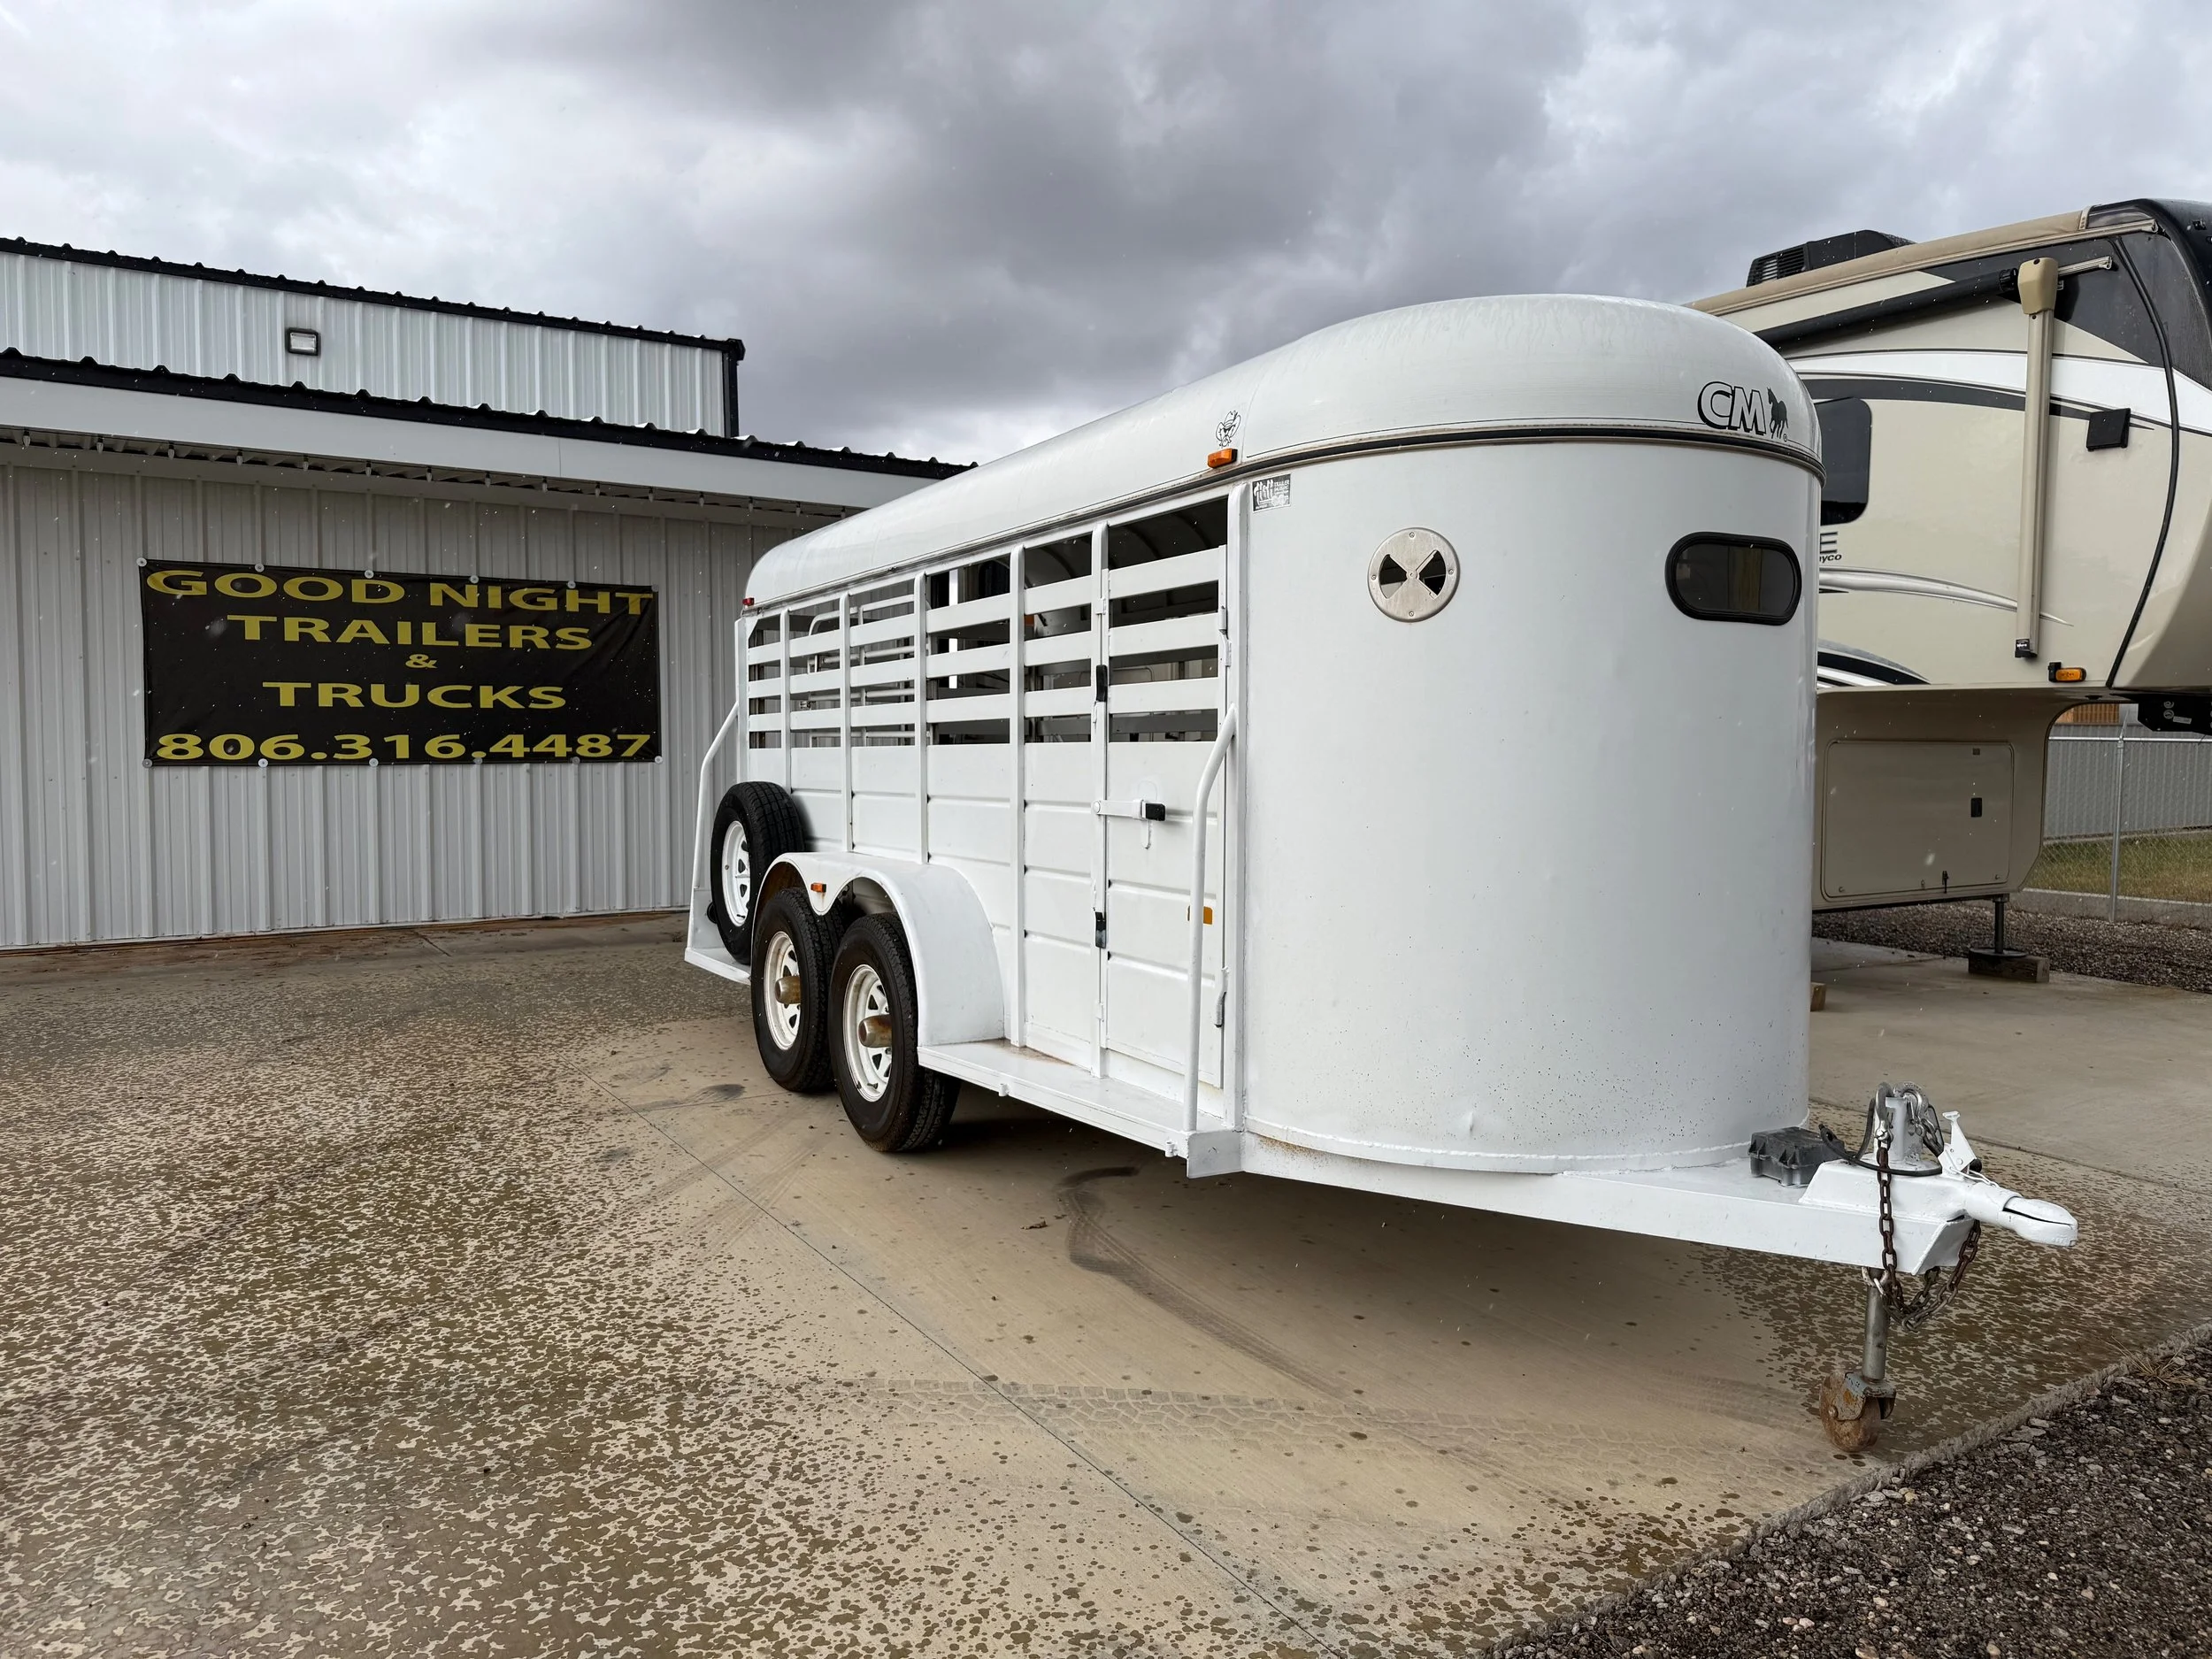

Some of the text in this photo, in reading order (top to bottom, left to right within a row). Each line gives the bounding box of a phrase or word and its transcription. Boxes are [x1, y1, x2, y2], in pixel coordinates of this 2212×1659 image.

[1697, 380, 1767, 436] CM
[146, 569, 654, 615] GOOD NIGHT
[227, 614, 593, 650] TRAILERS
[405, 653, 438, 669] &
[262, 681, 567, 710] TRUCKS
[157, 733, 650, 761] 806.316.4487
